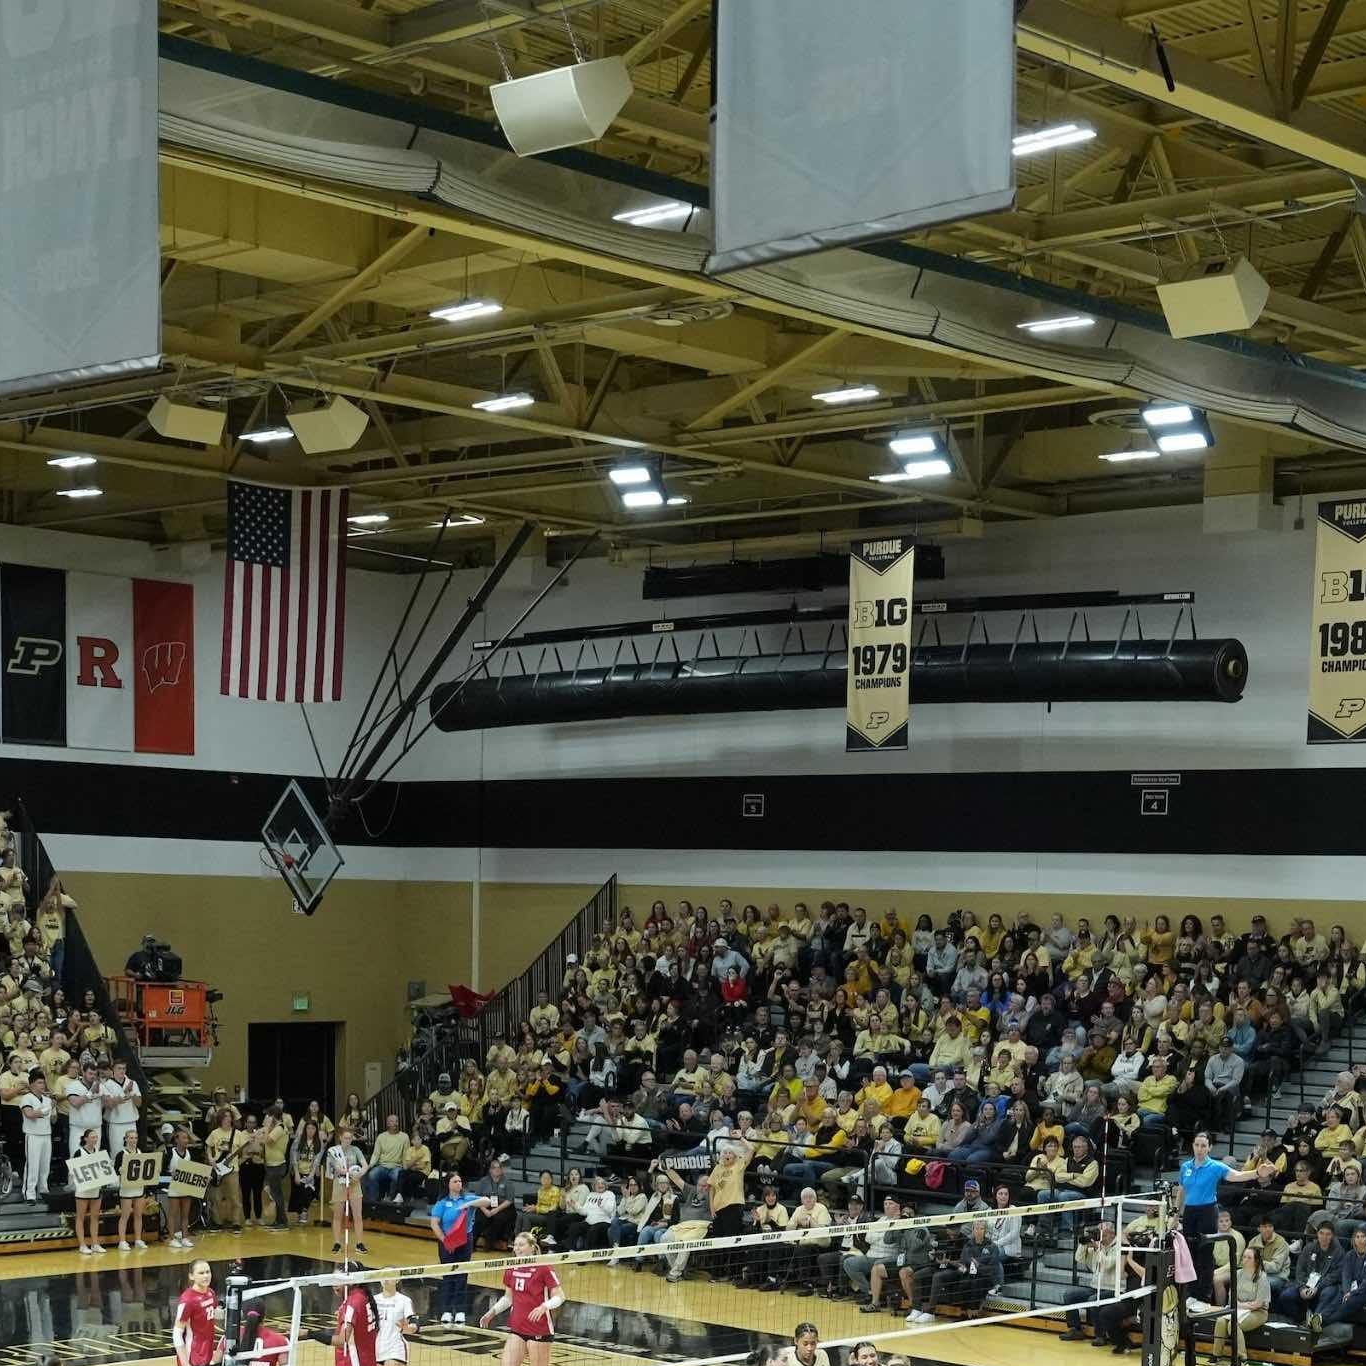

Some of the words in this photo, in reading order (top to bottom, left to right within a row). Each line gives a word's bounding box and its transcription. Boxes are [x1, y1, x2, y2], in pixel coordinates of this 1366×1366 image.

[862, 539, 902, 557] PURDUE
[76, 635, 123, 689] R
[852, 642, 907, 676] 1979
[855, 677, 902, 690] CHAMPIONS
[1150, 801, 1158, 810] 4
[73, 1159, 113, 1184] LET'S
[126, 1158, 156, 1182] GO
[666, 1154, 711, 1170] PURDUE
[173, 1168, 208, 1188] BOILERS
[514, 1278, 525, 1292] 13
